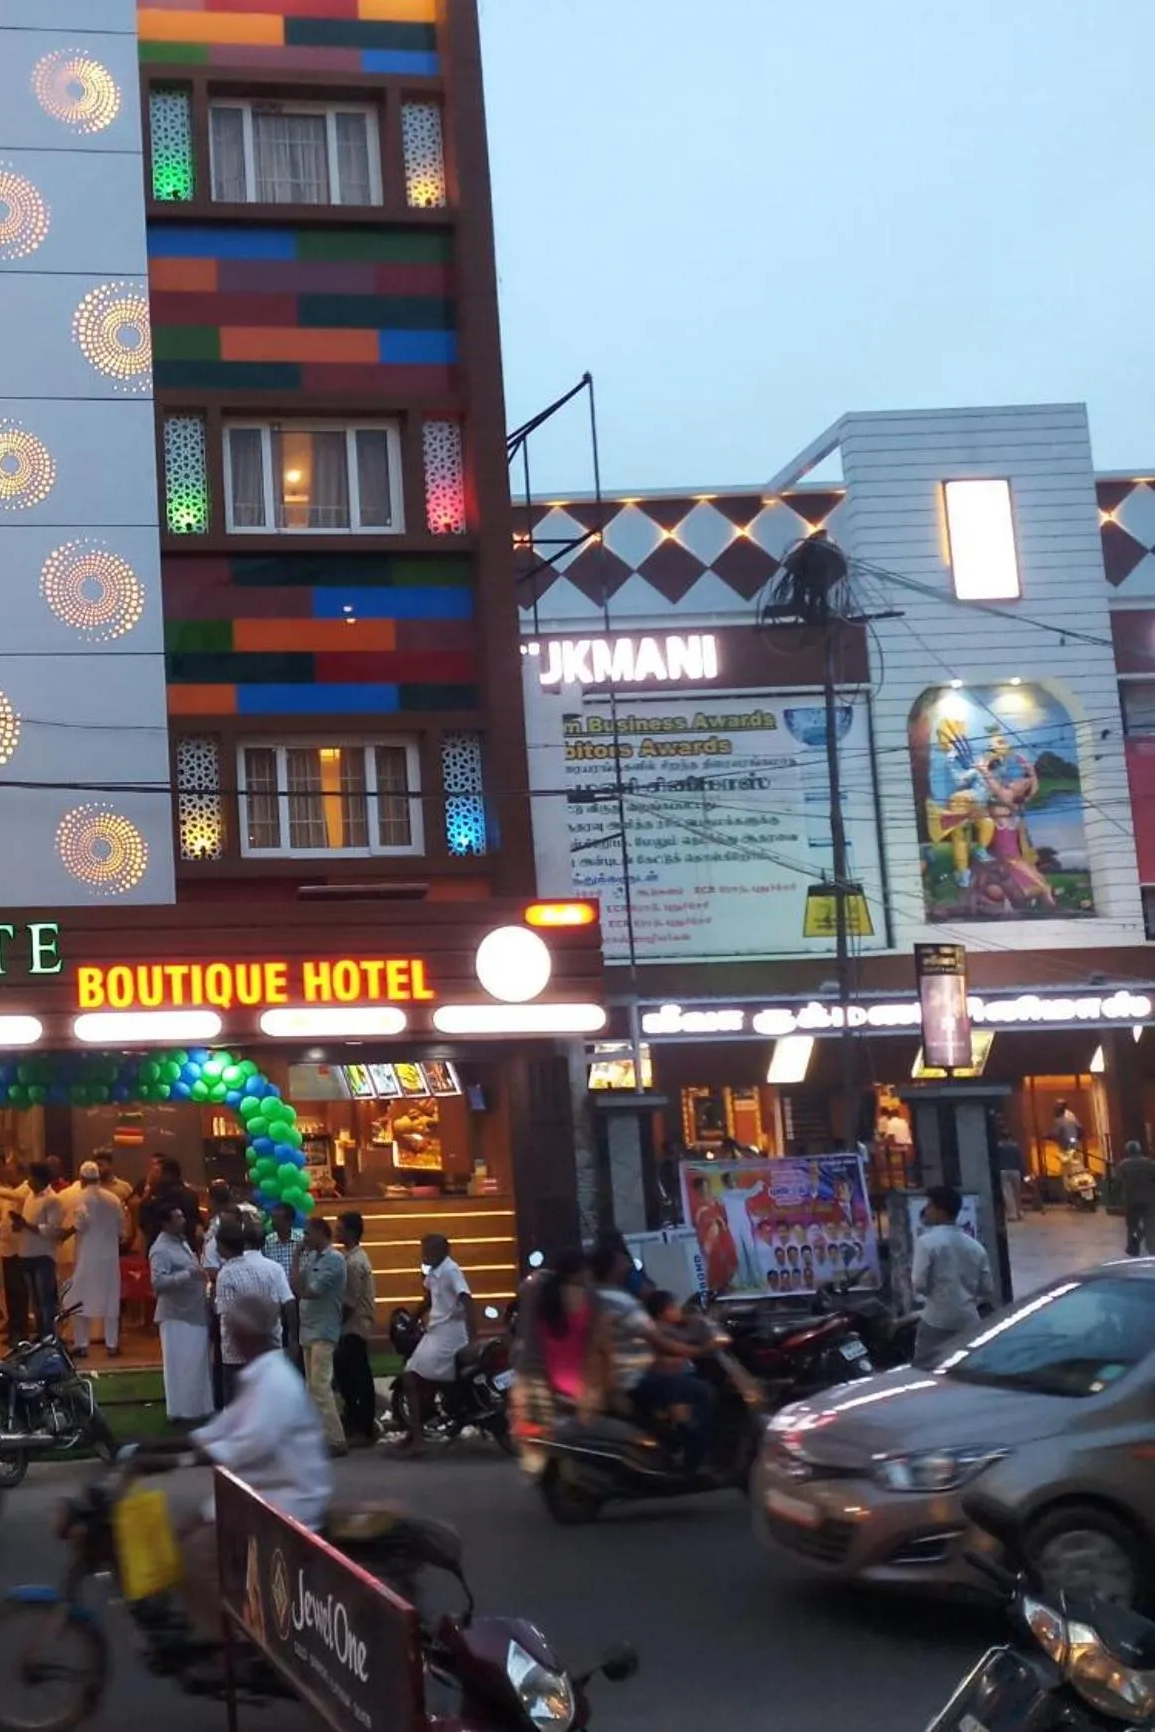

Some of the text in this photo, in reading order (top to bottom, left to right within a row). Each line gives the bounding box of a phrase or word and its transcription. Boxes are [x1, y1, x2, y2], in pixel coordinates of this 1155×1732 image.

[587, 714, 684, 734] Business
[694, 709, 776, 730] Awards
[638, 736, 733, 758] Awards
[77, 959, 434, 1009] BOUTIQUE HOTEL
[292, 1568, 369, 1682] JewelOne
